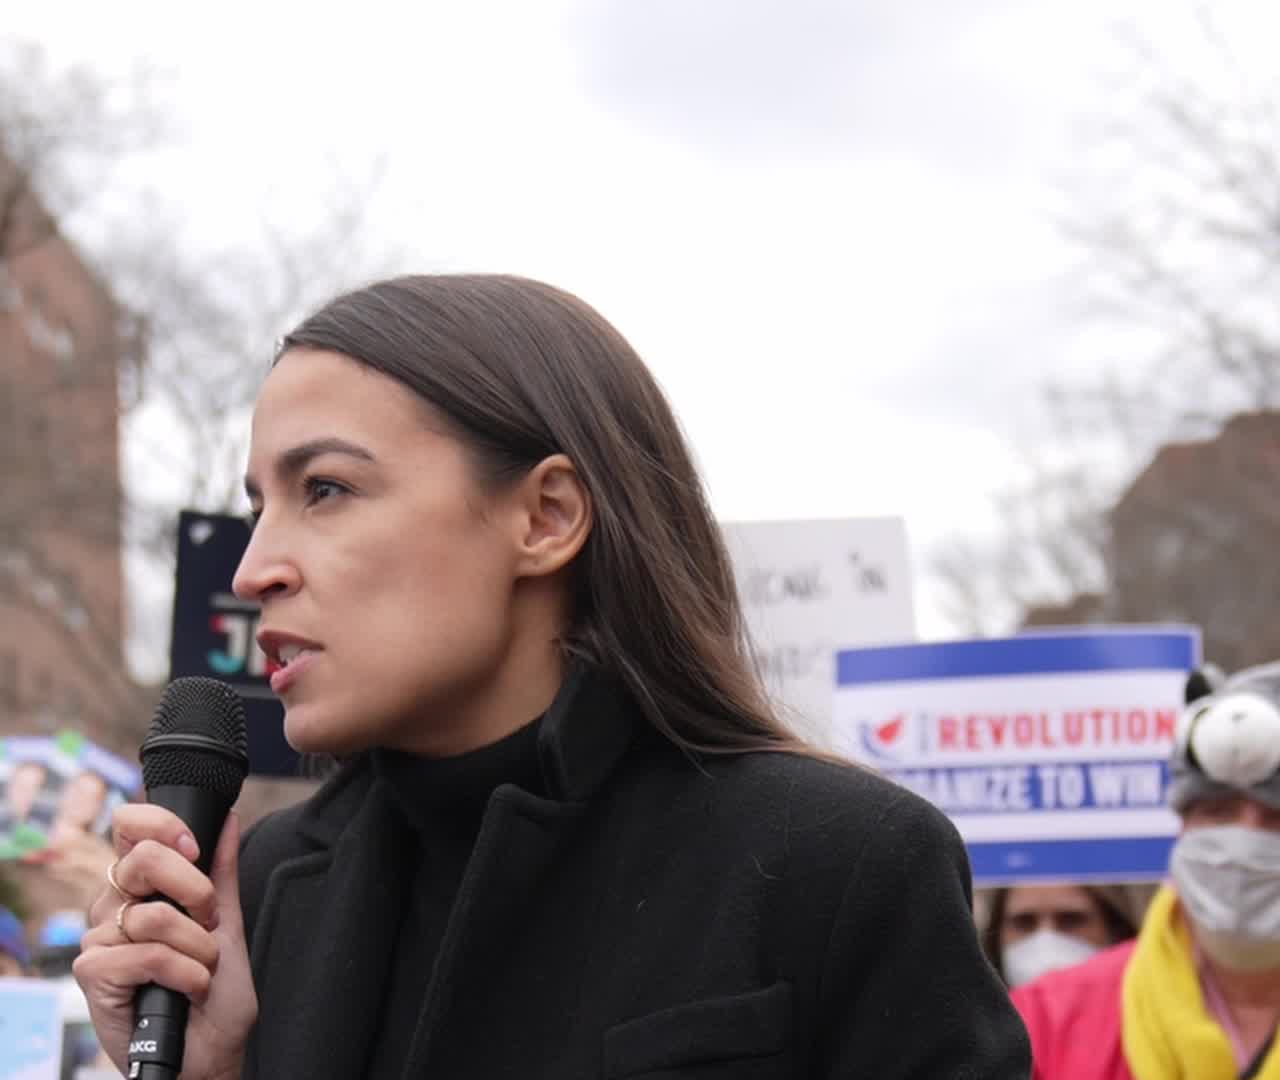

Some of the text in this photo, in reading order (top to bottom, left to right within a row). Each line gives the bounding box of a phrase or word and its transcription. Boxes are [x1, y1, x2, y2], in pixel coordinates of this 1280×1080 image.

[939, 708, 1176, 751] REVOLUTION
[1039, 762, 1086, 809] TO
[1088, 760, 1162, 808] WIN
